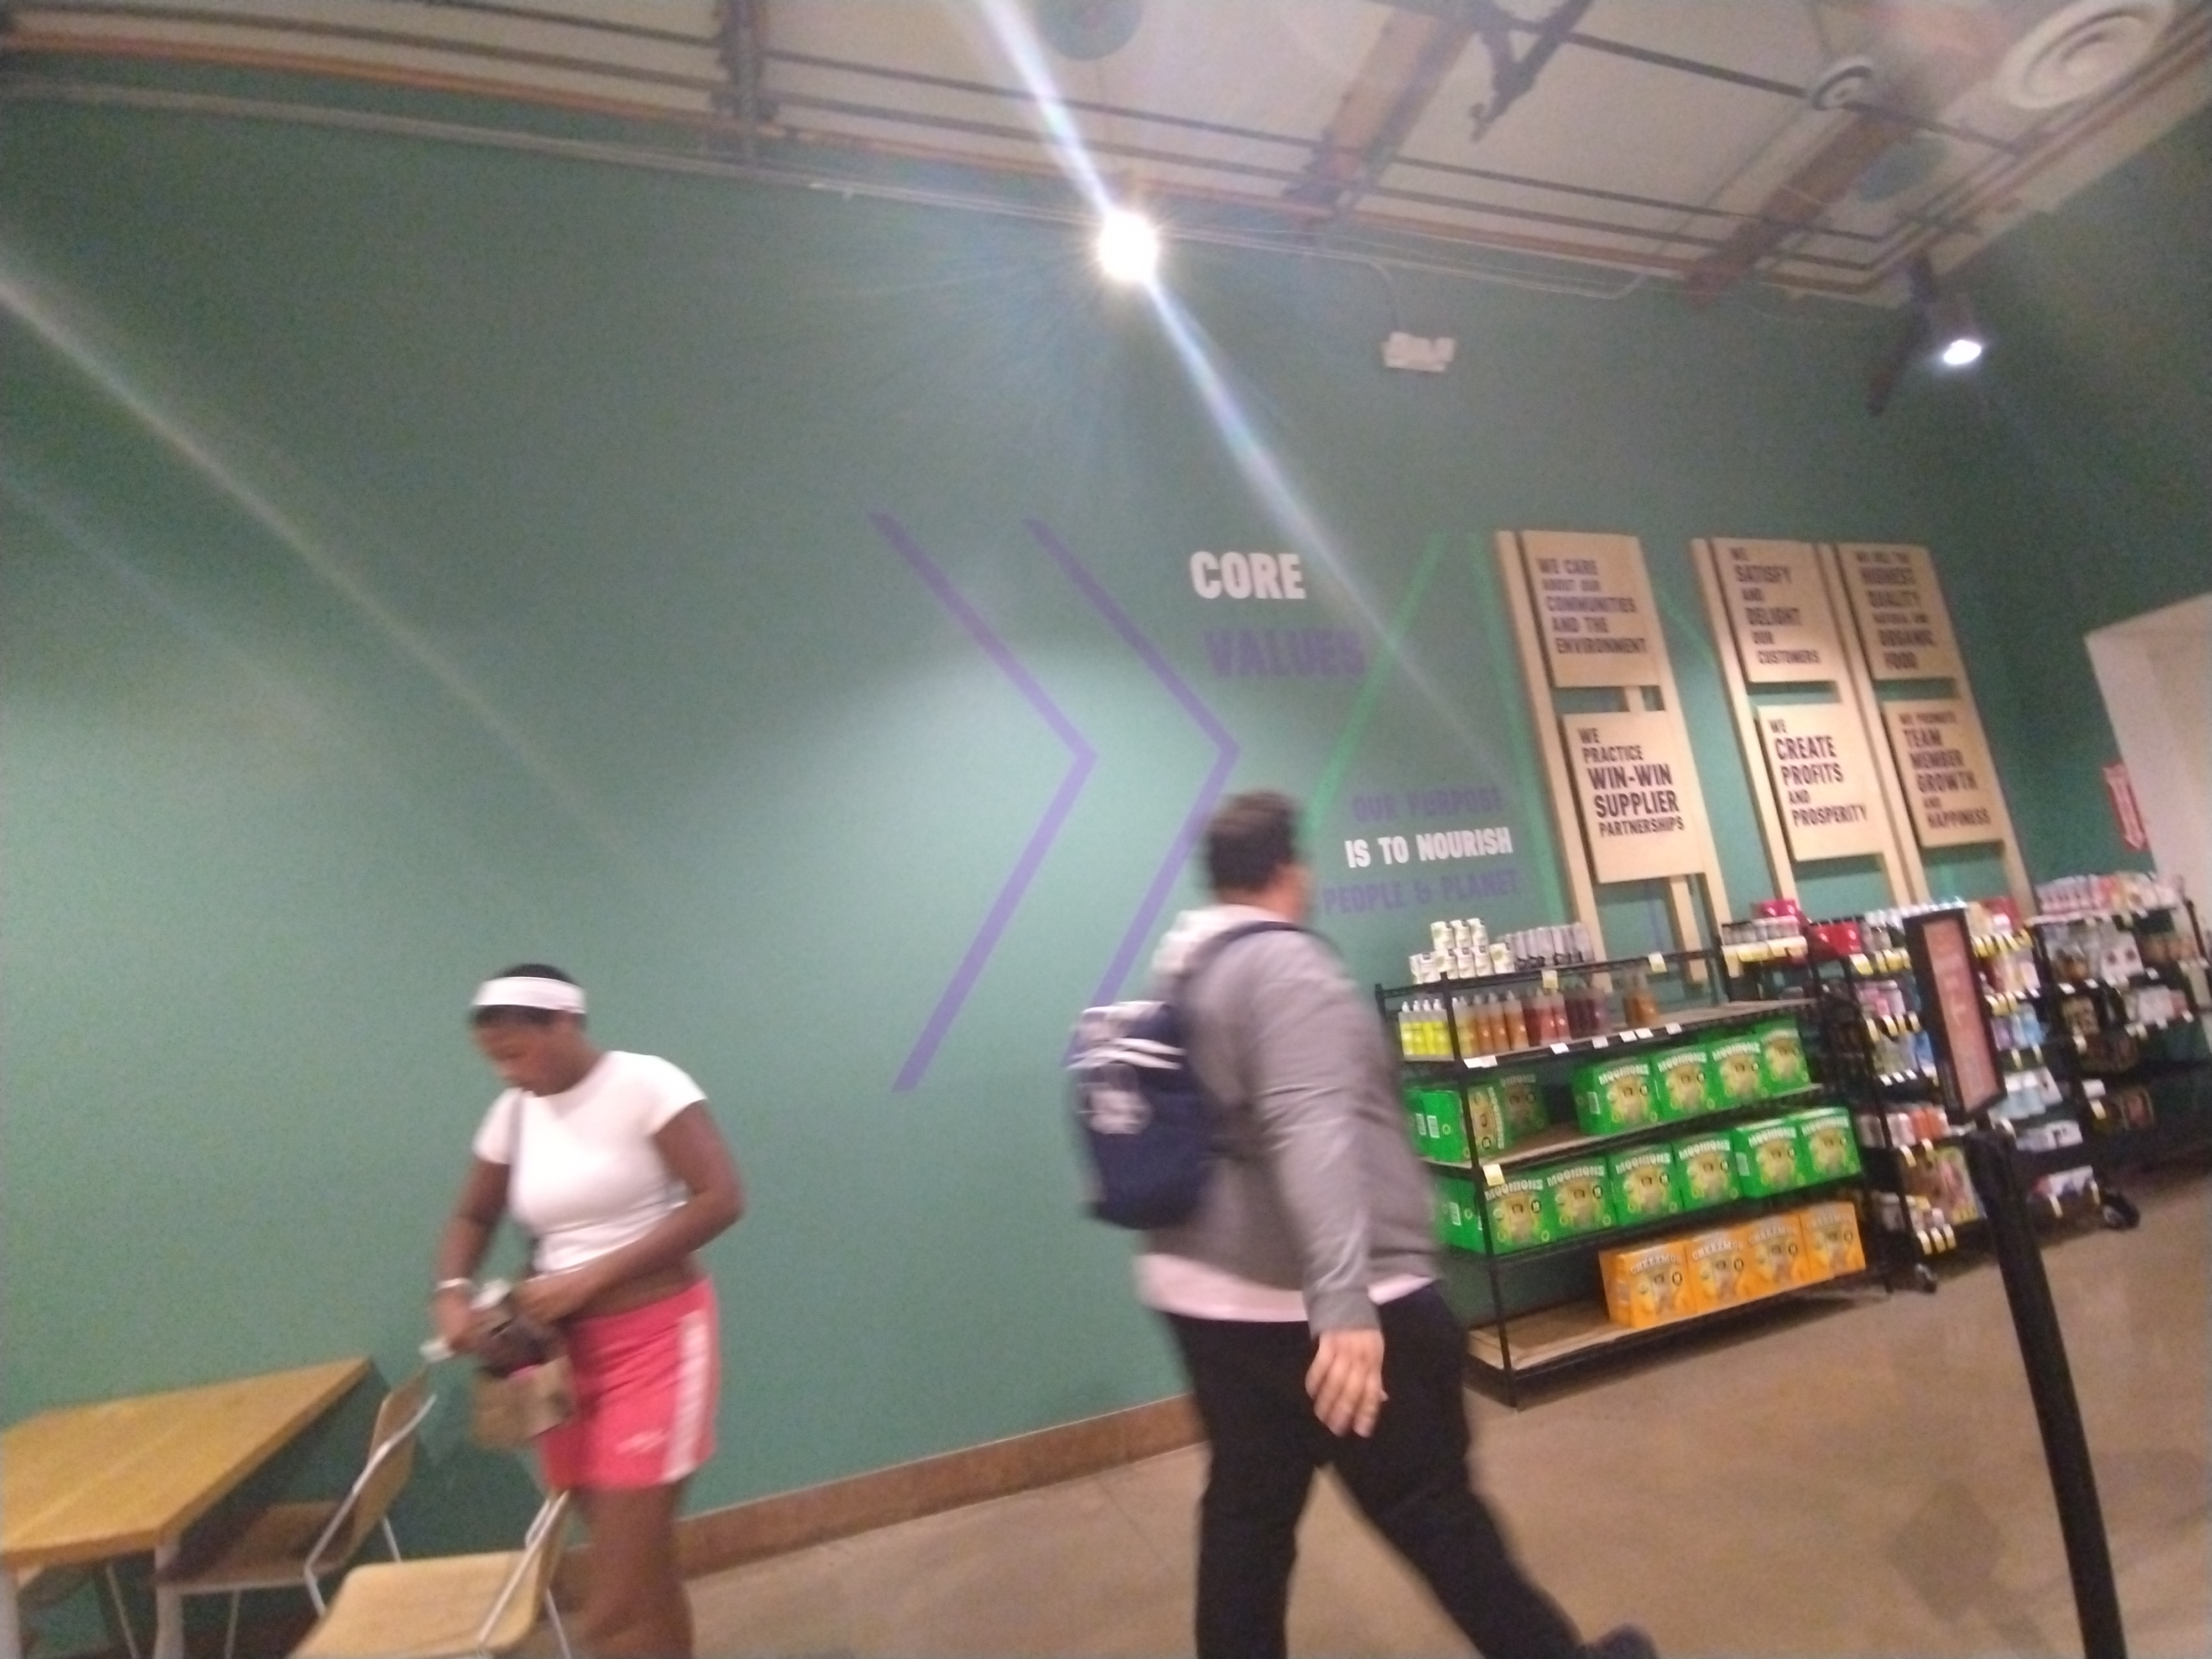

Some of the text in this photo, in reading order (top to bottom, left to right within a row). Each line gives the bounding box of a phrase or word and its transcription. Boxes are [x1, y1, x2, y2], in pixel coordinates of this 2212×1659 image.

[1730, 547, 1747, 560] WE
[1190, 551, 1306, 599] CORE
[1536, 559, 1598, 575] WE CARE
[1734, 565, 1792, 583] SATISFY
[1743, 588, 1764, 601] AND
[1866, 589, 1921, 607] QUALITY
[1546, 596, 1637, 613] COMMUNITIES
[1551, 617, 1609, 633] AND THE
[1745, 607, 1802, 626] DELIGHT
[1555, 637, 1647, 654] ENVIRONMENT
[1752, 631, 1775, 644] OUR
[1879, 629, 1936, 646] ORGANIC
[1201, 628, 1366, 677] VALUES
[1757, 649, 1821, 665] CUSTOMERS
[1884, 651, 1918, 670] FOOD
[1769, 719, 1787, 733] WE
[1578, 728, 1600, 744] WE
[1903, 728, 1943, 748] TEAM
[1582, 745, 1644, 763] PRACTICE
[1775, 735, 1837, 760] CREATE
[1910, 749, 1965, 769] MEMBER
[1587, 764, 1673, 790] WIN-WIN
[1781, 761, 1844, 786] PROFITS
[1917, 770, 1979, 793] GROWTH
[1353, 785, 1503, 822] OUR PURPOSE
[1594, 790, 1680, 818] SUPPLIER
[1788, 789, 1811, 804] AND
[1791, 804, 1867, 827] PROSPERITY
[1926, 807, 1991, 828] HAPPINESS
[1599, 816, 1686, 837] PARTNERSHIPS
[1344, 827, 1514, 868] IS TO NOURISH
[1323, 881, 1403, 914] PEOPLE
[1440, 867, 1519, 902] PLANET
